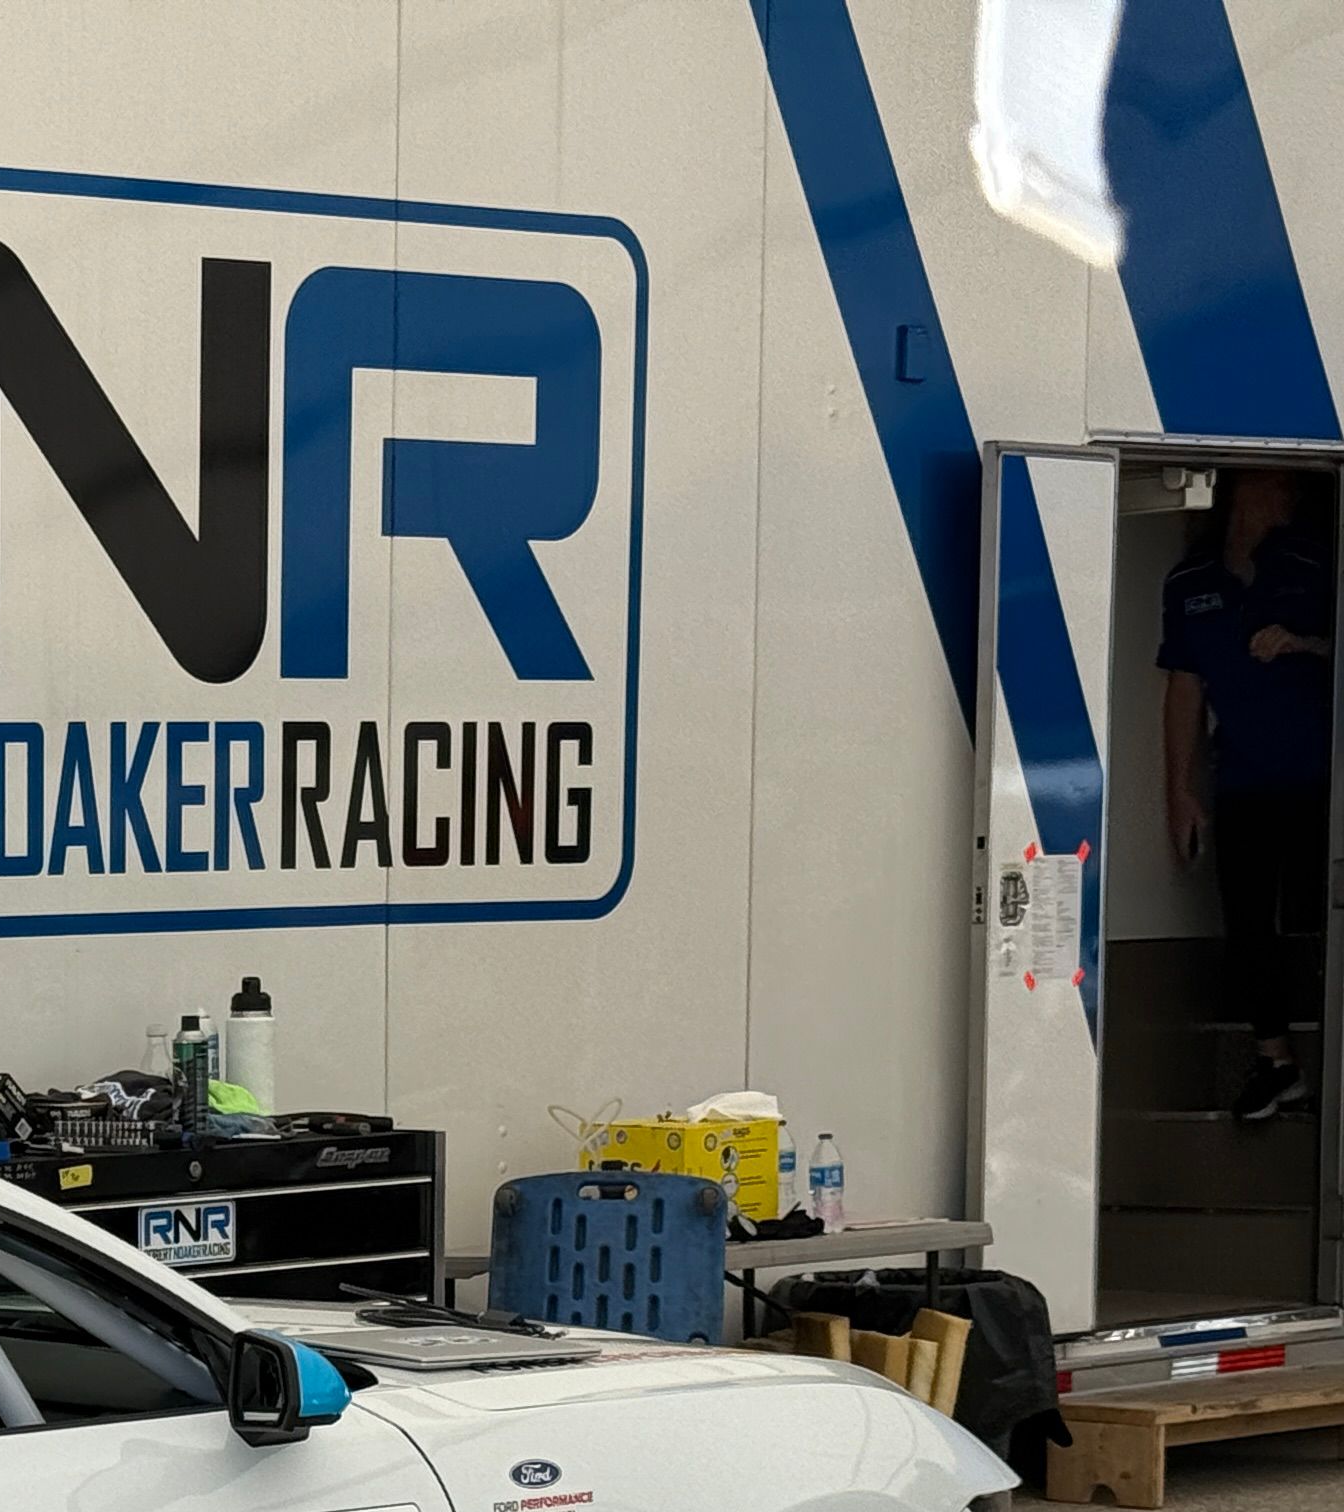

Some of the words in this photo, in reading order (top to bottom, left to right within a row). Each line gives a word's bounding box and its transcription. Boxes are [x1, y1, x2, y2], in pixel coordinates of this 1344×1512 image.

[280, 720, 594, 868] RACING
[144, 1205, 230, 1246] RNR
[520, 1464, 552, 1483] Ford
[520, 1491, 593, 1510] PERFORMANCE
